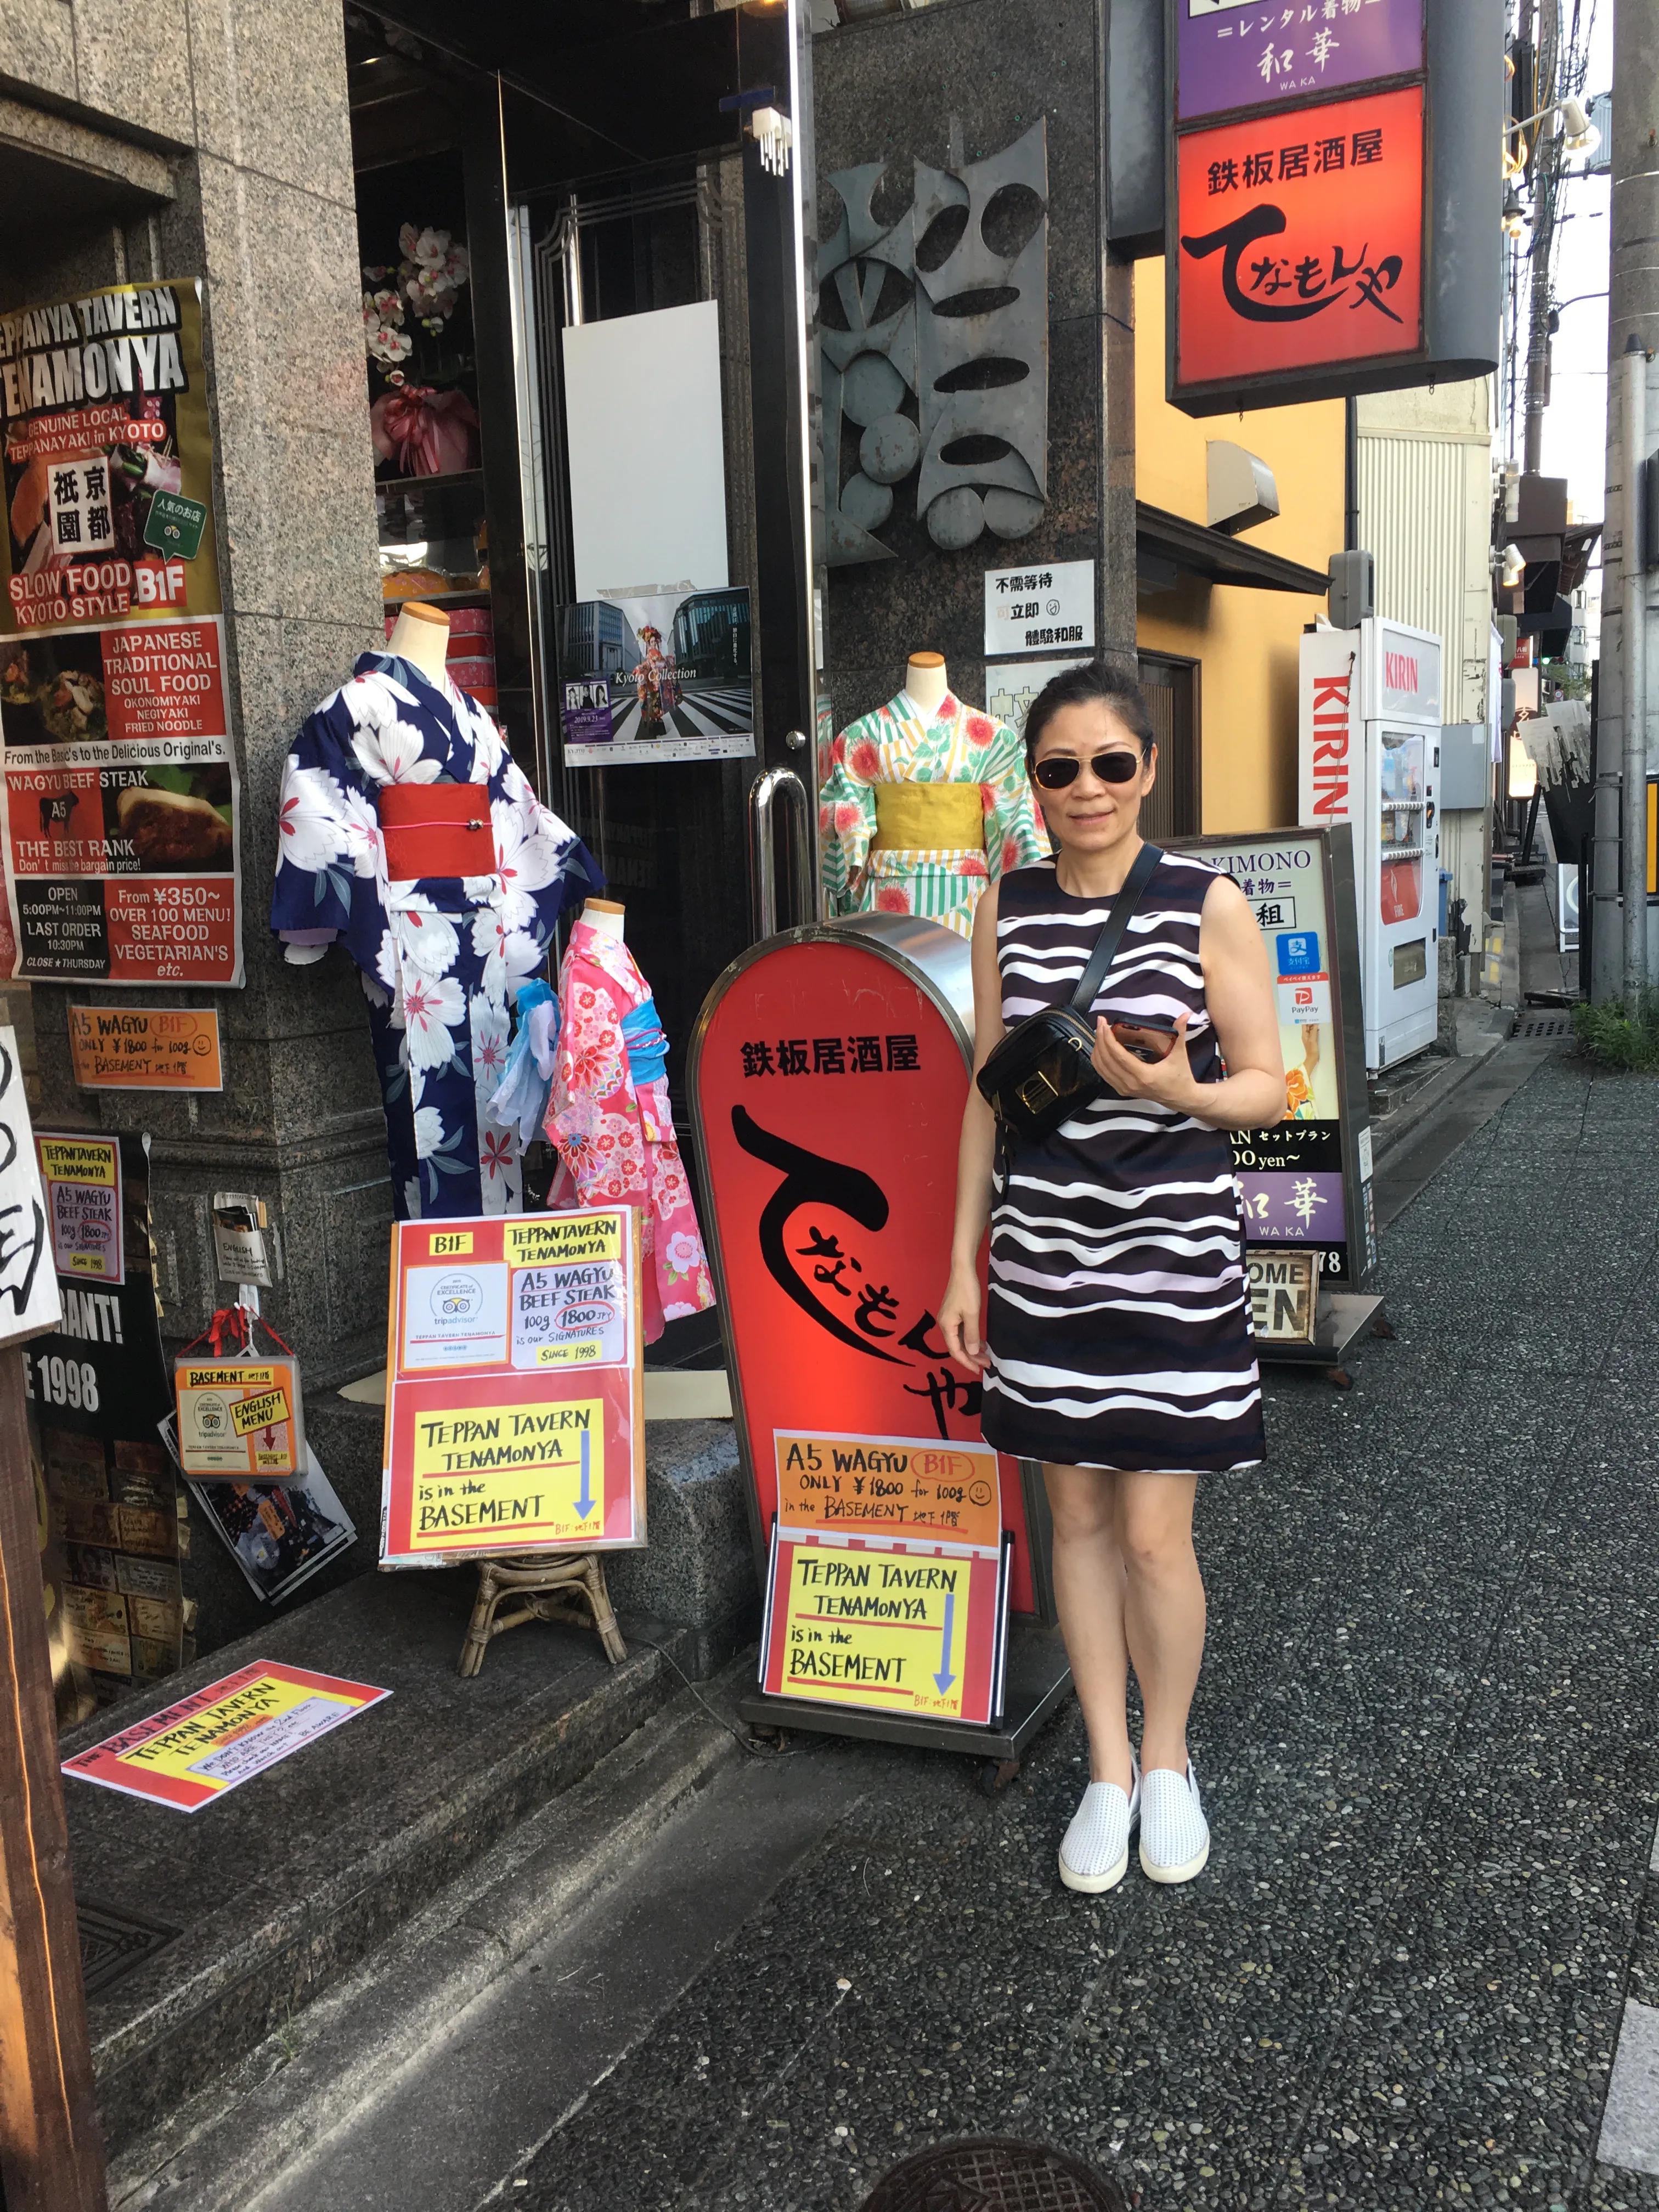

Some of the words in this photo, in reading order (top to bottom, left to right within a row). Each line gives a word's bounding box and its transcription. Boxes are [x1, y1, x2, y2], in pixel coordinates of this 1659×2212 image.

[1280, 81, 1296, 91] WA
[1300, 76, 1316, 86] KA
[1207, 128, 1383, 196] 鉄板居酒屋
[77, 286, 176, 336] TAVERN
[2, 332, 184, 417] ENAMONYA
[29, 414, 79, 437] GENUINE
[83, 407, 127, 427] LOCAL
[10, 433, 90, 461] TEPPANAYAKI
[94, 430, 105, 444] in
[109, 422, 164, 439] KYOTO
[83, 466, 110, 541] 京都
[157, 498, 201, 523] 人気のお店
[10, 570, 60, 601] SLOW
[66, 563, 131, 593] FOOD
[136, 565, 184, 603] B1F
[995, 572, 1053, 594] 不需等待
[15, 599, 66, 624] KYOTO
[72, 592, 128, 618] STYLE
[112, 631, 202, 654] JAPANESE
[1025, 625, 1083, 646] 體驗和服
[104, 652, 217, 675] TRADITIONAL
[1385, 651, 1418, 693] KIRIN
[112, 677, 155, 696] SOUL
[160, 673, 211, 692] FOOD
[616, 672, 644, 687] Kyoto
[648, 667, 697, 682] Collection
[125, 695, 200, 709] OKONOMIYAKI
[137, 708, 188, 720] NEGIYAKI
[125, 721, 154, 733] FRIED
[156, 719, 202, 732] NOODLE
[4, 751, 33, 765] From
[36, 749, 50, 764] the
[80, 747, 91, 761] to
[93, 746, 109, 761] the
[112, 743, 160, 759] Delicious
[163, 740, 226, 759] Original's.
[1313, 676, 1350, 815] KIRIN
[8, 775, 61, 791] WAGYU
[64, 772, 94, 789] BEEF
[99, 770, 149, 788] STEAK
[52, 802, 66, 819] A5
[16, 840, 49, 857] THE
[53, 839, 83, 857] BEST
[89, 839, 135, 856] RANK
[52, 860, 69, 871] miss
[81, 859, 115, 874] bargain
[117, 858, 141, 872] price!
[1212, 850, 1311, 874] KIMONO
[48, 887, 78, 901] OPEN
[118, 890, 150, 904] From
[110, 908, 146, 922] OVER
[151, 908, 178, 922] 100
[183, 908, 231, 923] MENU!
[26, 923, 58, 936] LAST
[62, 923, 101, 937] ORDER
[132, 925, 209, 941] SEAFOOD
[48, 940, 84, 951] 10:30PM
[114, 945, 228, 961] VEGETARIAN'S
[157, 963, 183, 977] etc.
[72, 1012, 91, 1036] A5
[97, 1015, 148, 1036] WAGYU
[79, 1039, 104, 1054] ONLY
[151, 1038, 163, 1053] for
[169, 1041, 191, 1054] 100g
[741, 1034, 921, 1079] 鉄板居酒屋
[94, 1056, 151, 1075] BASEMENT
[1259, 1130, 1330, 1142] セットプラン
[50, 1164, 106, 1178] TENAMONYA
[57, 1185, 72, 1204] A5
[75, 1189, 111, 1205] WAGYU
[57, 1205, 81, 1220] BEEF
[82, 1207, 112, 1221] STEAK
[61, 1224, 76, 1240] 100g
[82, 1224, 101, 1239] 1800
[507, 1227, 558, 1246] TEPPAN
[557, 1220, 617, 1239] TAVERN
[1259, 1226, 1279, 1236] WA
[1285, 1226, 1304, 1237] KA
[223, 1242, 253, 1257] ENGLISH
[434, 1234, 467, 1254] B1F
[517, 1239, 606, 1262] TENAMONYA
[91, 1259, 103, 1270] 1998
[1248, 1262, 1304, 1284] OME
[521, 1269, 548, 1292] A5
[554, 1266, 613, 1289] WAGYU
[520, 1291, 561, 1312] BEEF
[564, 1284, 616, 1306] STEAK
[524, 1314, 549, 1331] 100g
[560, 1310, 596, 1328] 1800
[596, 1311, 612, 1321] JPY
[1251, 1288, 1306, 1331] EN
[435, 1317, 475, 1325] tripadvisor
[516, 1335, 525, 1345] is
[527, 1335, 544, 1344] our
[548, 1327, 605, 1342] SIGNATURES
[540, 1349, 569, 1361] SINCE
[574, 1345, 596, 1358] 1998
[37, 1355, 99, 1412] 1998
[190, 1370, 245, 1386] BASEMENT
[234, 1392, 281, 1419] ENGLISH
[241, 1409, 273, 1430] MENU
[421, 1418, 500, 1448] TEPPAN
[509, 1409, 590, 1437] TAVERN
[442, 1438, 563, 1471] TENAMONYA
[786, 1443, 822, 1471] A5
[832, 1448, 908, 1474] WAGYU
[923, 1454, 964, 1475] B1F
[419, 1485, 433, 1501] is
[438, 1482, 454, 1498] in
[460, 1479, 486, 1496] the
[799, 1475, 842, 1493] ONLY
[911, 1480, 929, 1498] for
[936, 1483, 967, 1502] 100g
[419, 1494, 545, 1531] BASEMENT
[785, 1499, 796, 1512] in
[799, 1499, 815, 1513] the
[824, 1496, 909, 1522] BASEMENT
[797, 1559, 870, 1588] TEPPAN
[878, 1563, 958, 1593] TAVERN
[814, 1595, 927, 1620] TENAMONYA
[791, 1627, 804, 1643] is
[808, 1628, 822, 1643] in
[828, 1627, 853, 1645] the
[789, 1649, 907, 1683] BASEMENT
[97, 1694, 217, 1754] BASEMENT
[122, 1720, 212, 1765] TEPPAN
[198, 1682, 280, 1722] TAVERN
[163, 1696, 285, 1758] TENAMONYA
